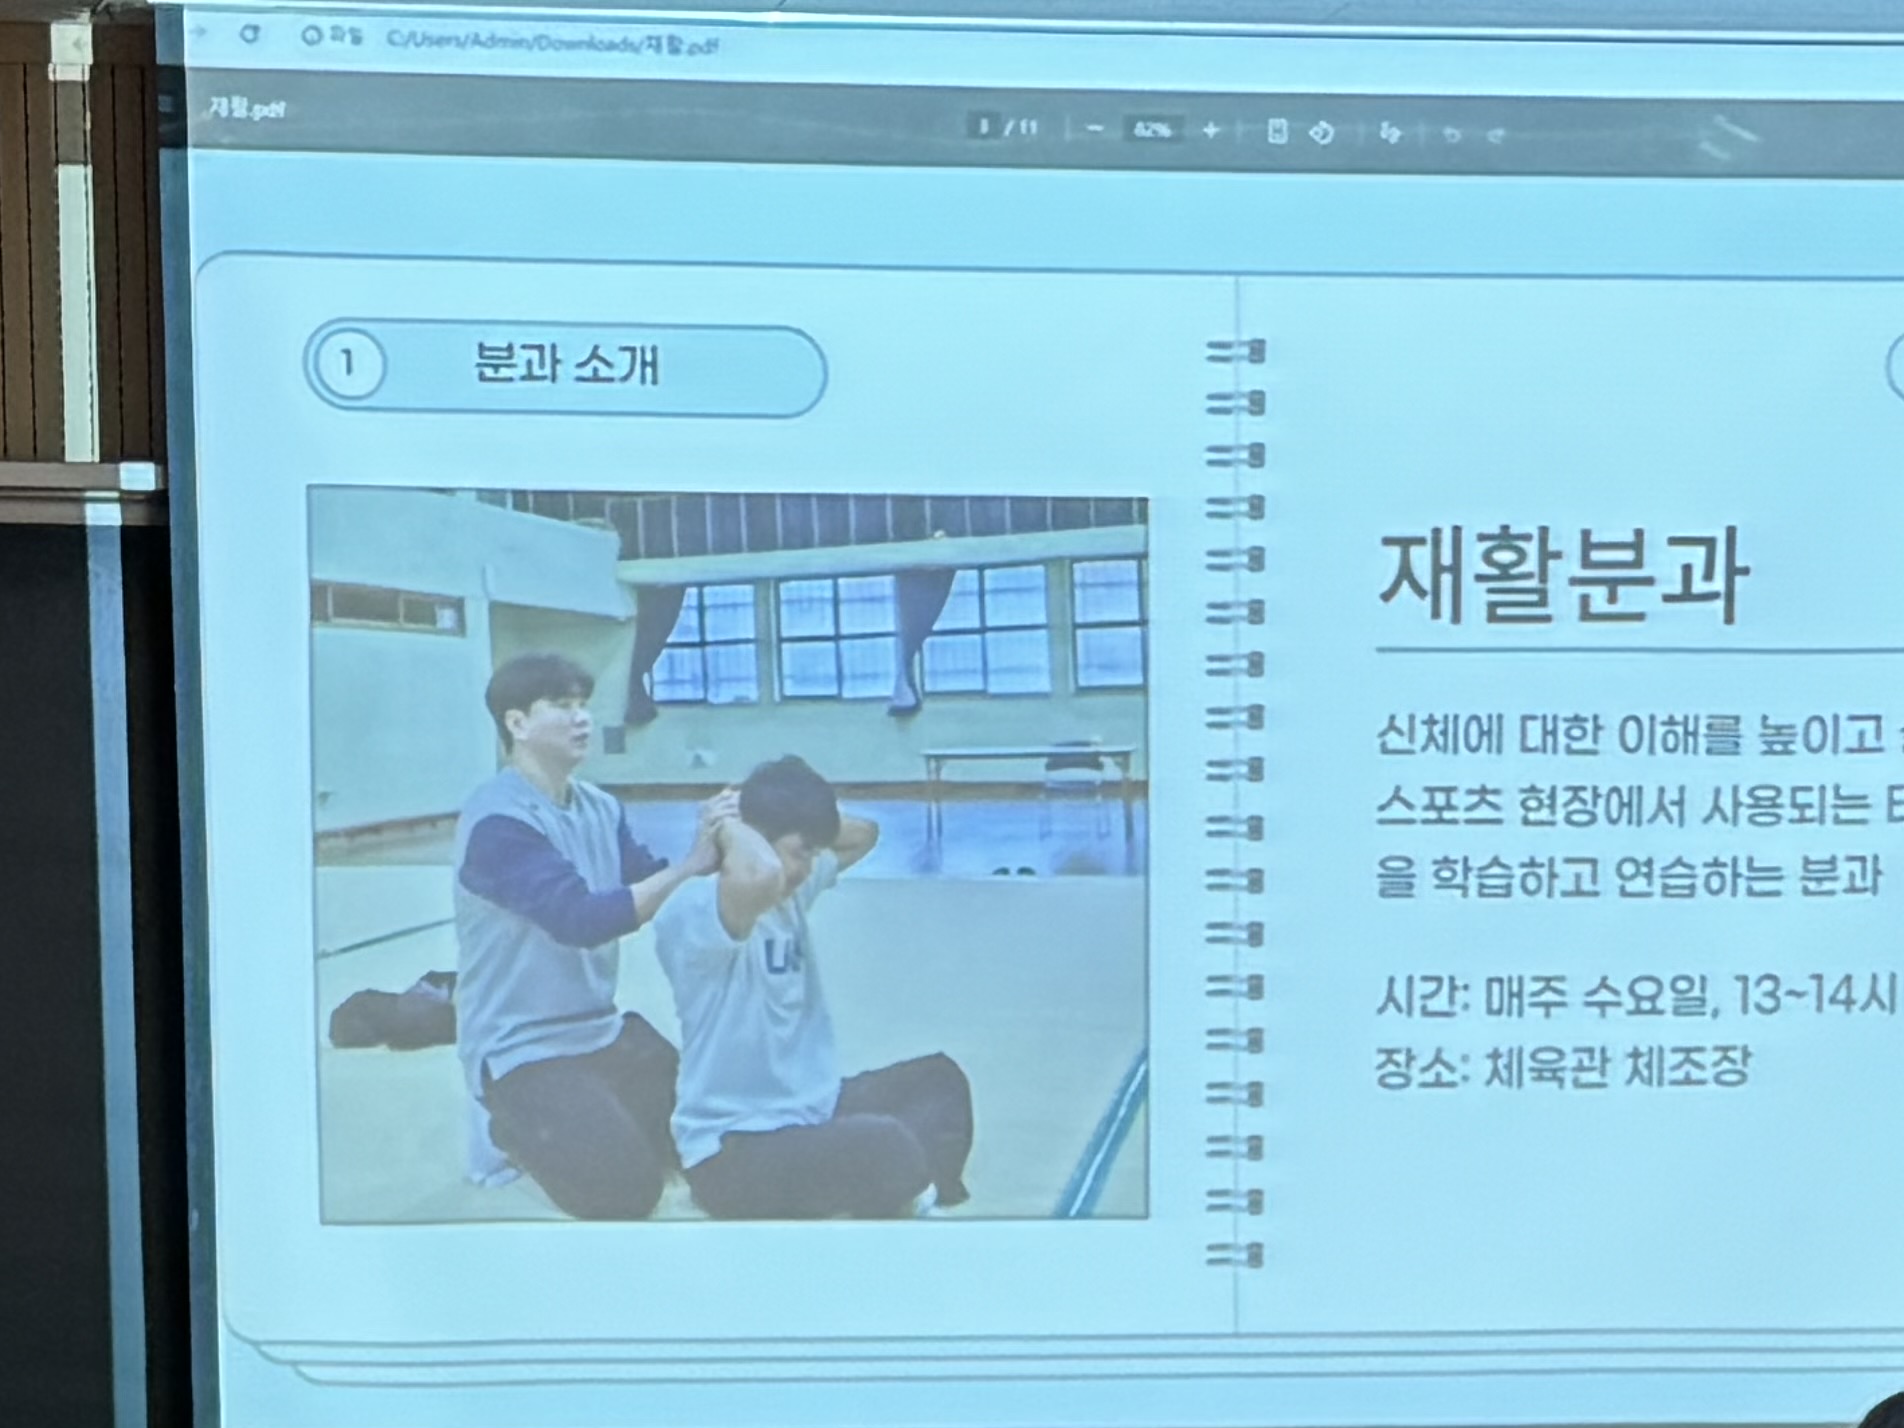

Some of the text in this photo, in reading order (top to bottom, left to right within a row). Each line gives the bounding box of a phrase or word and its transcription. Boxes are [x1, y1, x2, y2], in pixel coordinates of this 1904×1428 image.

[338, 347, 355, 378] 1
[474, 342, 662, 389] 분과 소개
[1377, 524, 1751, 626] 재활분과
[1376, 713, 1505, 758] 신체에
[1520, 713, 1604, 758] 대한
[1619, 713, 1743, 757] 이해를
[1758, 713, 1885, 758] 높이고
[1376, 784, 1504, 828] 스포츠
[1519, 784, 1687, 828] 현장에서
[1701, 784, 1873, 827] 사용되는
[1376, 854, 1883, 899] 을 학습하고 연습하는 분과
[1376, 972, 1899, 1020] 시간: 매주 수요일, 13~14시
[1375, 1045, 1753, 1090] 장소: 체육관 체조장
